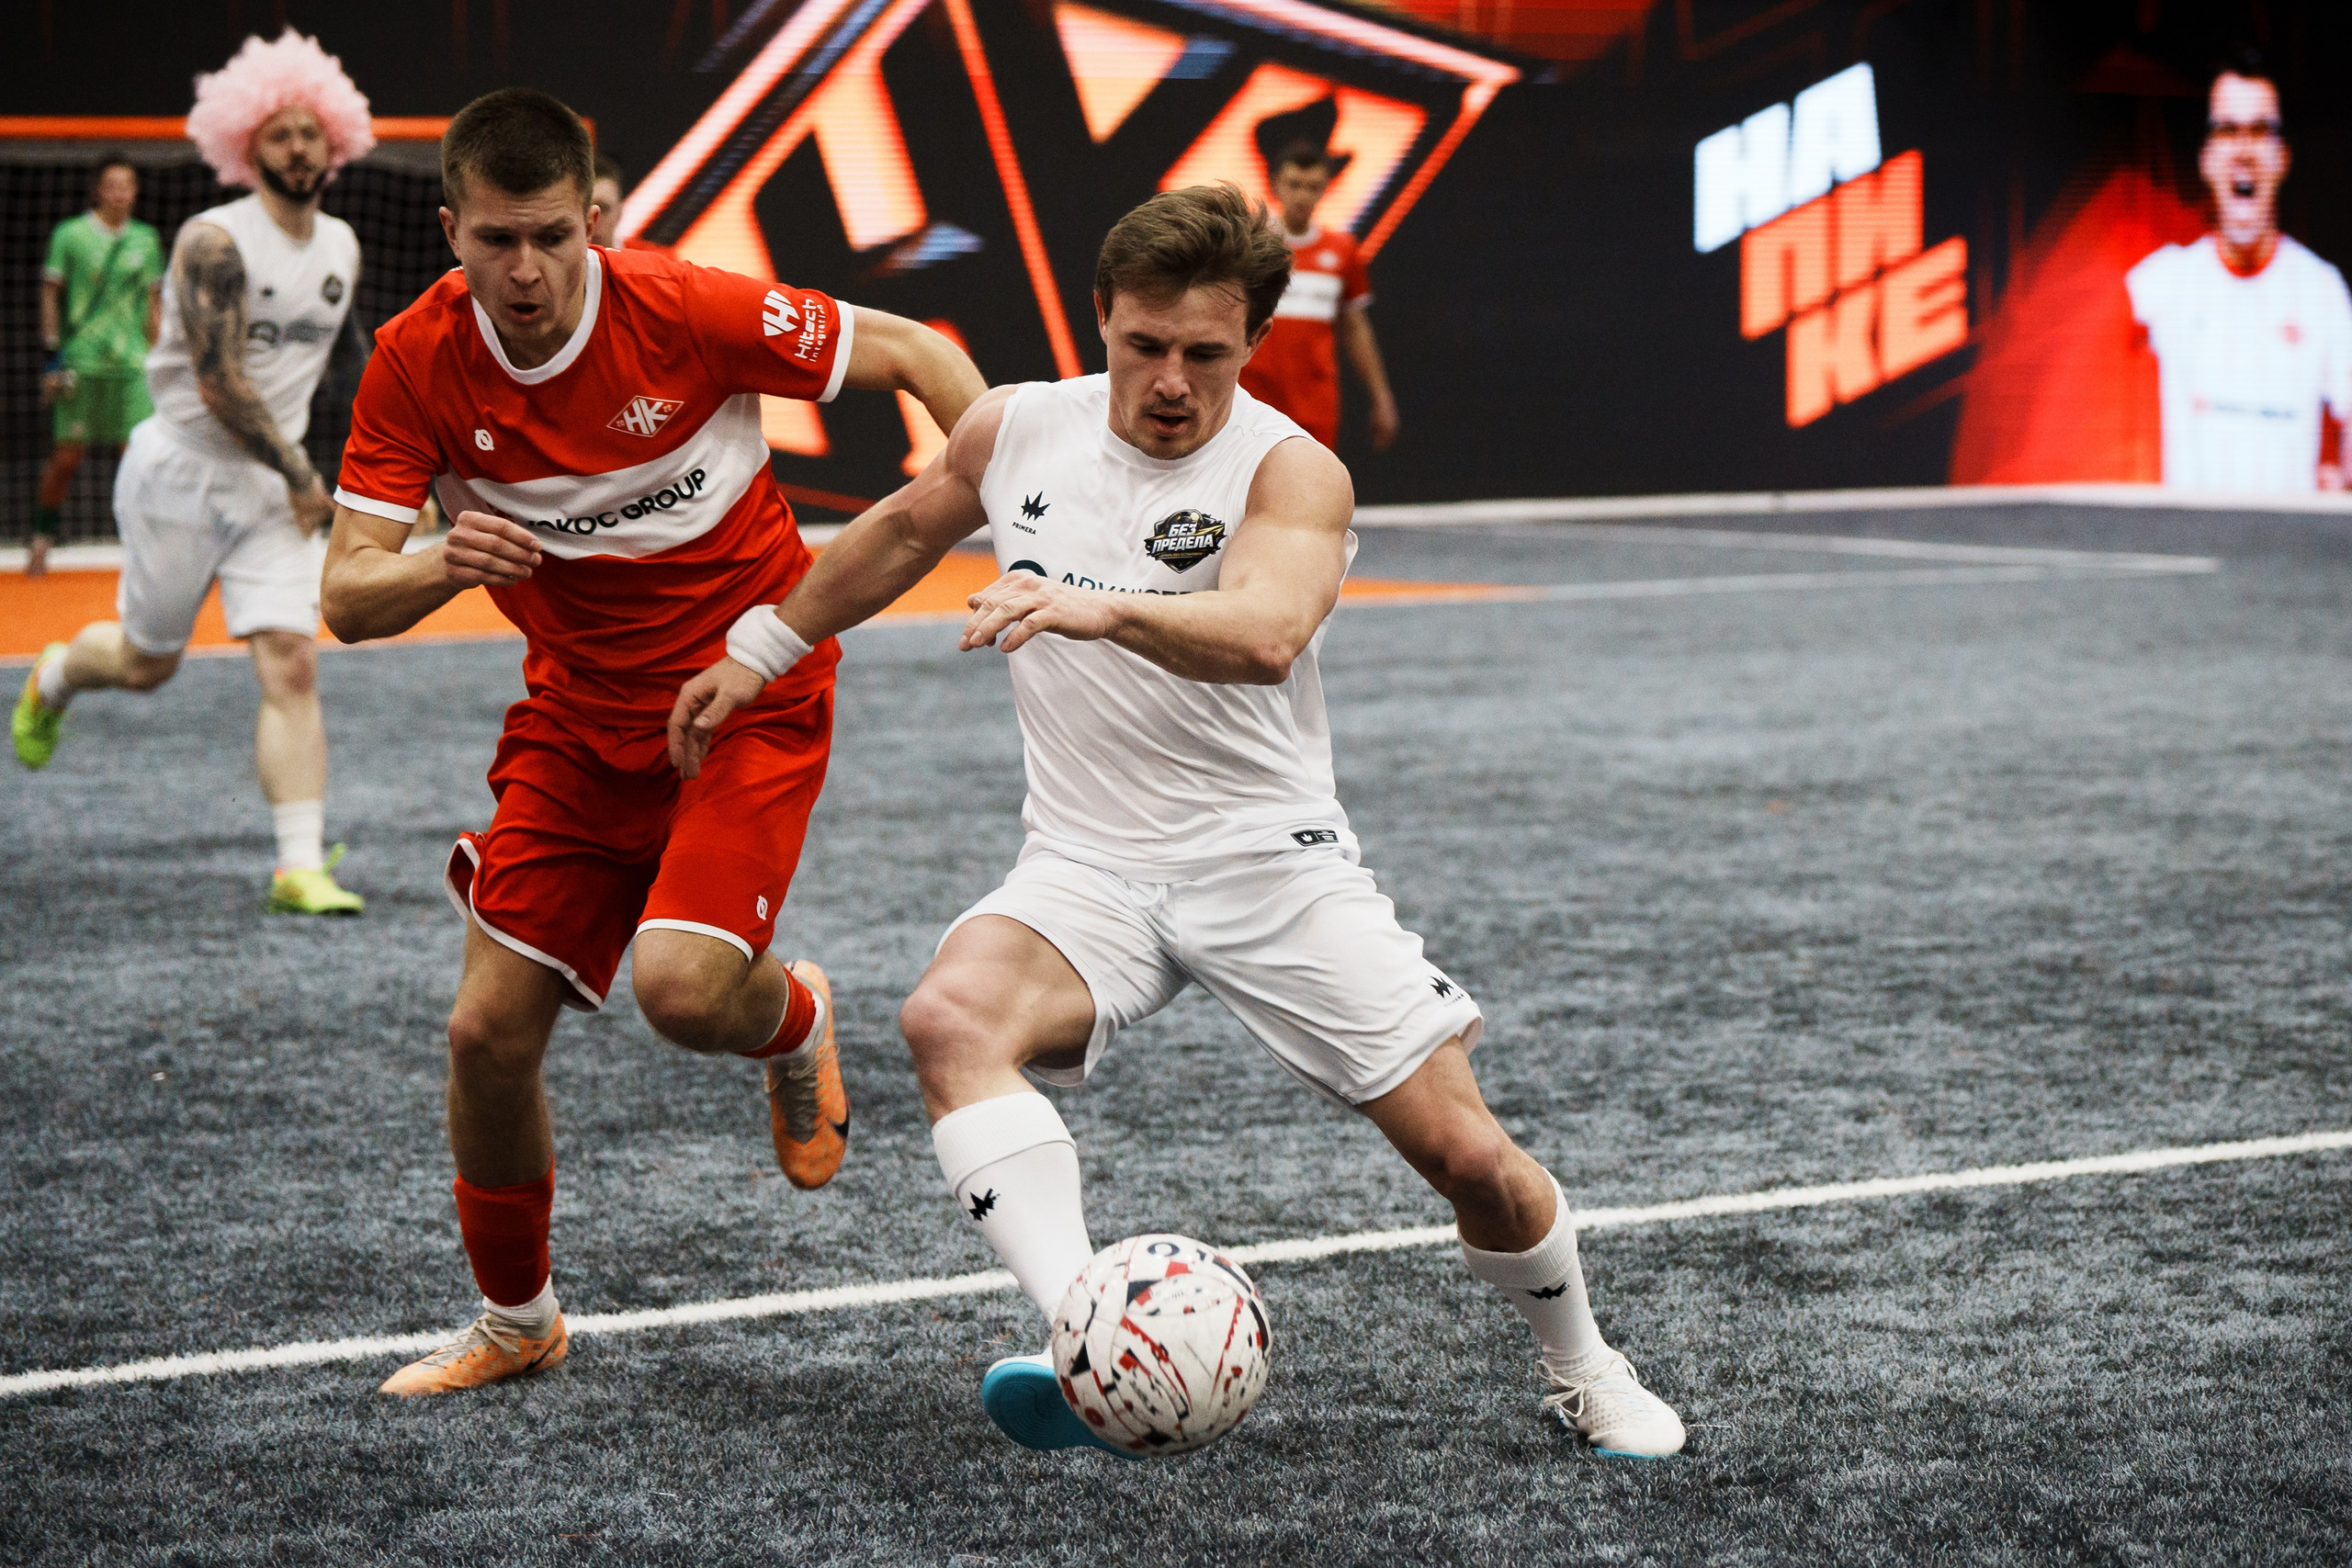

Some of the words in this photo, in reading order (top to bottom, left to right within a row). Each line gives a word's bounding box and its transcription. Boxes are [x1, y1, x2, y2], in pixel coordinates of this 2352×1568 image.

[794, 298, 817, 359] Hitech
[620, 468, 707, 520] GROUP
[1012, 521, 1036, 536] PRIMERA
[1168, 523, 1196, 537] БЕЗ
[1151, 534, 1214, 554] ПРЕДЕЛА
